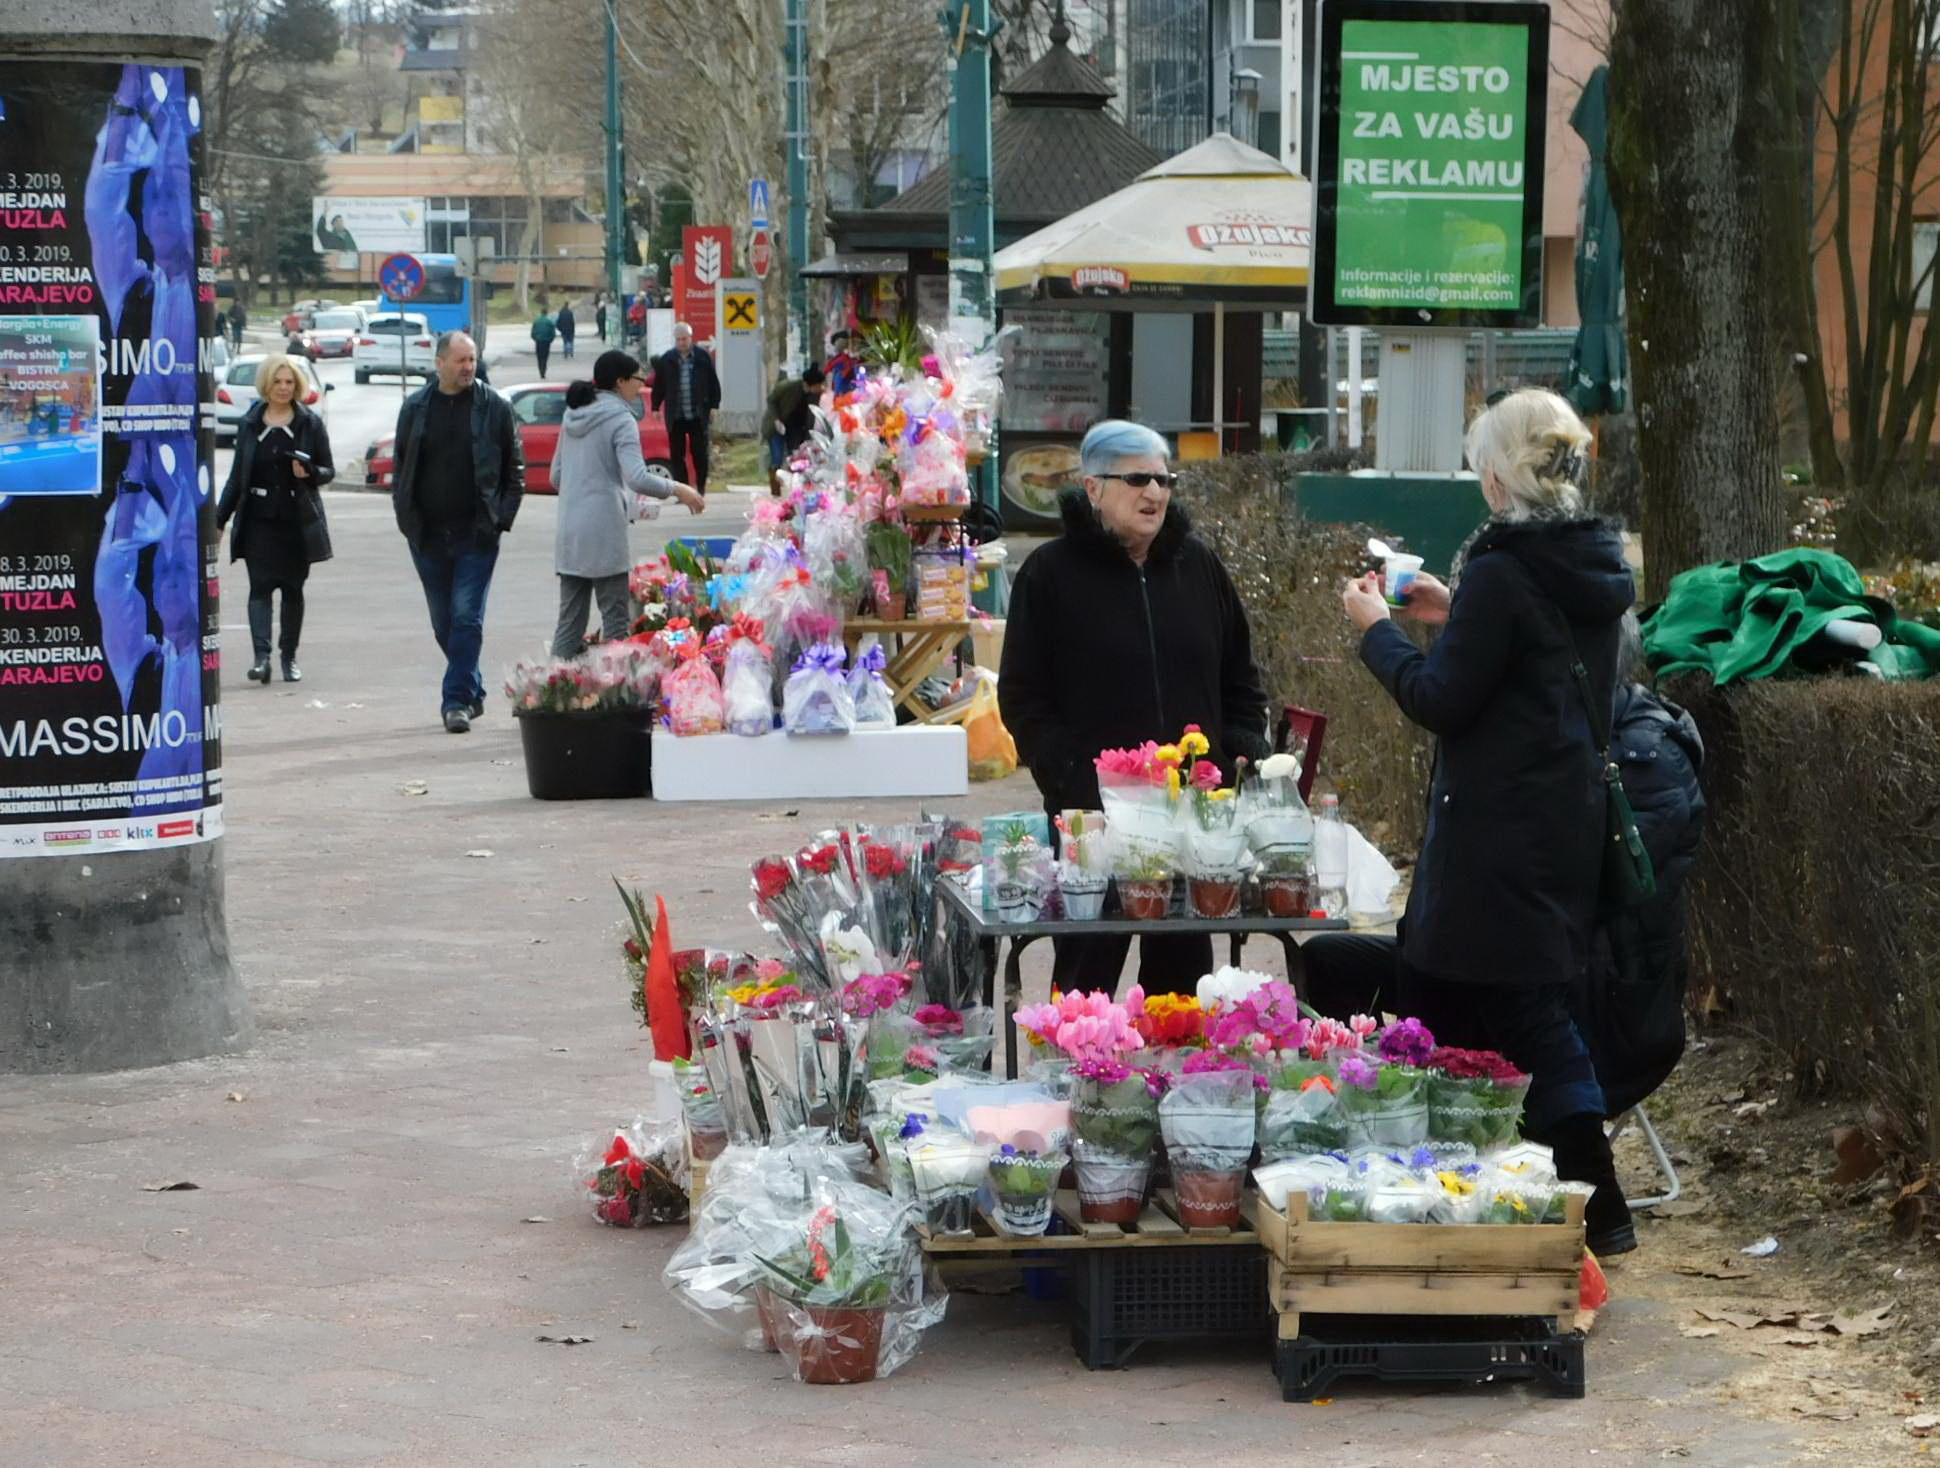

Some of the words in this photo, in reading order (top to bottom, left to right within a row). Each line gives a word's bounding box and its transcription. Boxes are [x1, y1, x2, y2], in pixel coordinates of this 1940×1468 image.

[1361, 64, 1510, 93] MJESTO
[1353, 111, 1402, 138] ZA
[1414, 107, 1513, 139] VAŠU
[25, 173, 65, 189] 2019.
[1343, 158, 1523, 187] REKLAMU
[33, 245, 73, 262] 2019.
[17, 555, 31, 572] 3.
[34, 554, 74, 572] 2019.
[0, 573, 76, 591] MEJDAN
[1, 590, 77, 611] TUZLA
[1, 628, 24, 644] 30.
[26, 627, 40, 643] 3.
[44, 625, 84, 643] 2019.
[0, 709, 187, 758] MASSIMO
